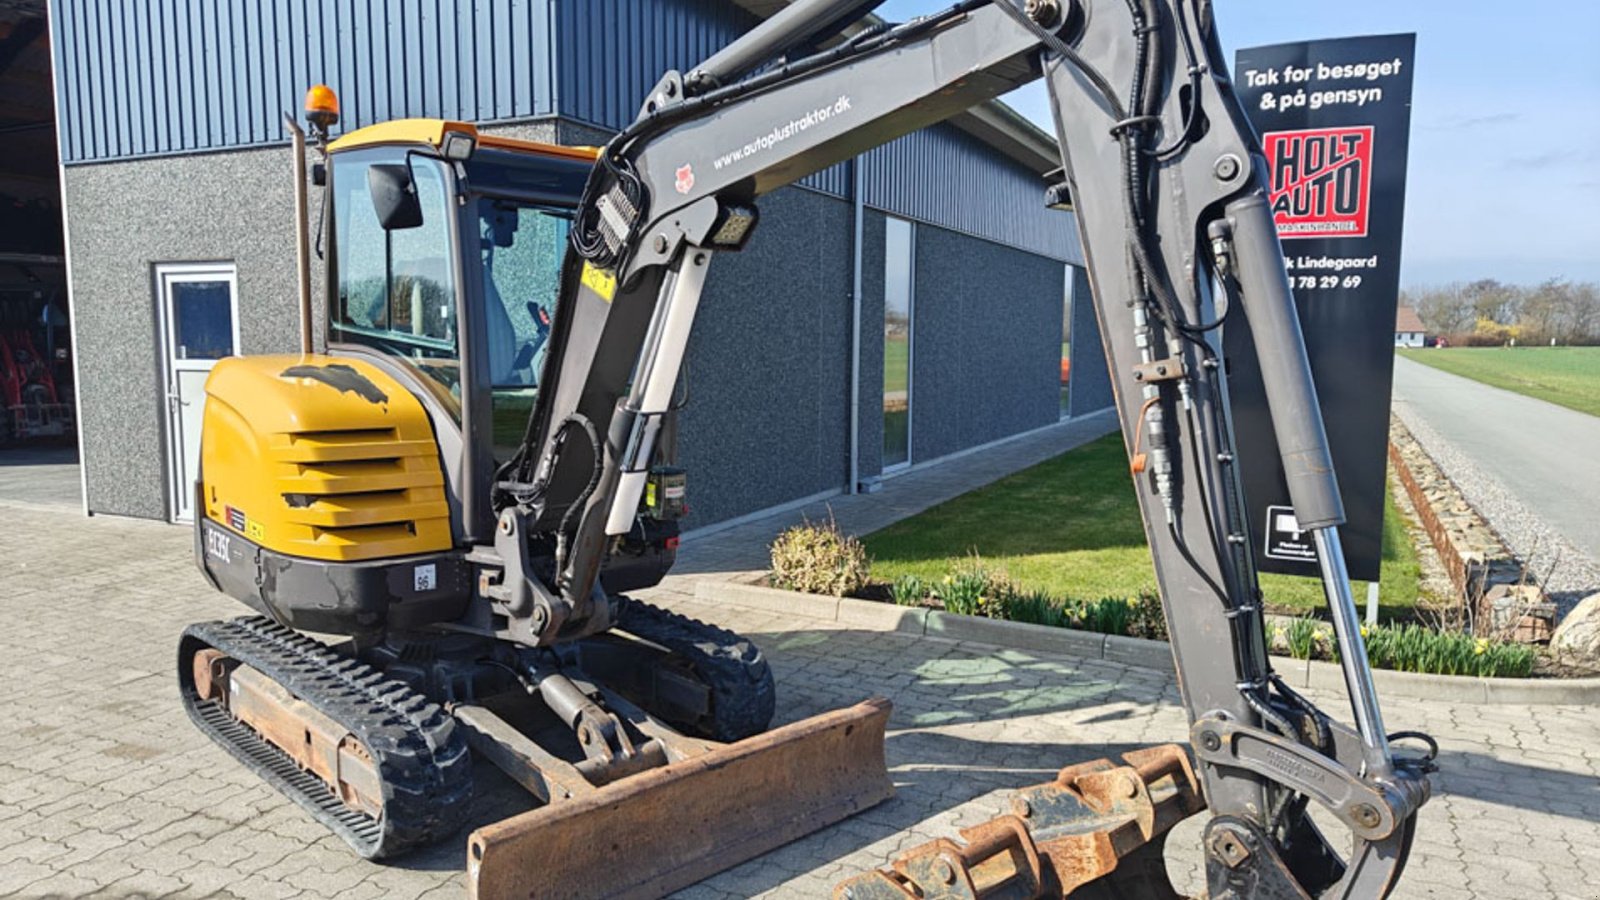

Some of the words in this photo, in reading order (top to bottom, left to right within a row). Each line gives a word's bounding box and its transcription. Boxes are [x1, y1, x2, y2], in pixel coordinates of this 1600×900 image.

[1245, 68, 1279, 87] Tak
[1283, 65, 1313, 83] for
[1317, 58, 1402, 81] besøget
[1259, 93, 1276, 110] &
[1280, 89, 1306, 111] på
[1310, 87, 1382, 110] gensyn
[713, 95, 851, 170] www.autoplustraktor.dk
[1274, 134, 1364, 193] HOLT
[1272, 158, 1361, 217] AUTO
[1278, 221, 1357, 231] MASKINHANDEL
[1297, 255, 1377, 271] Lindegaard
[1299, 276, 1316, 288] 78
[1320, 275, 1339, 288] 29
[1342, 275, 1362, 288] 69
